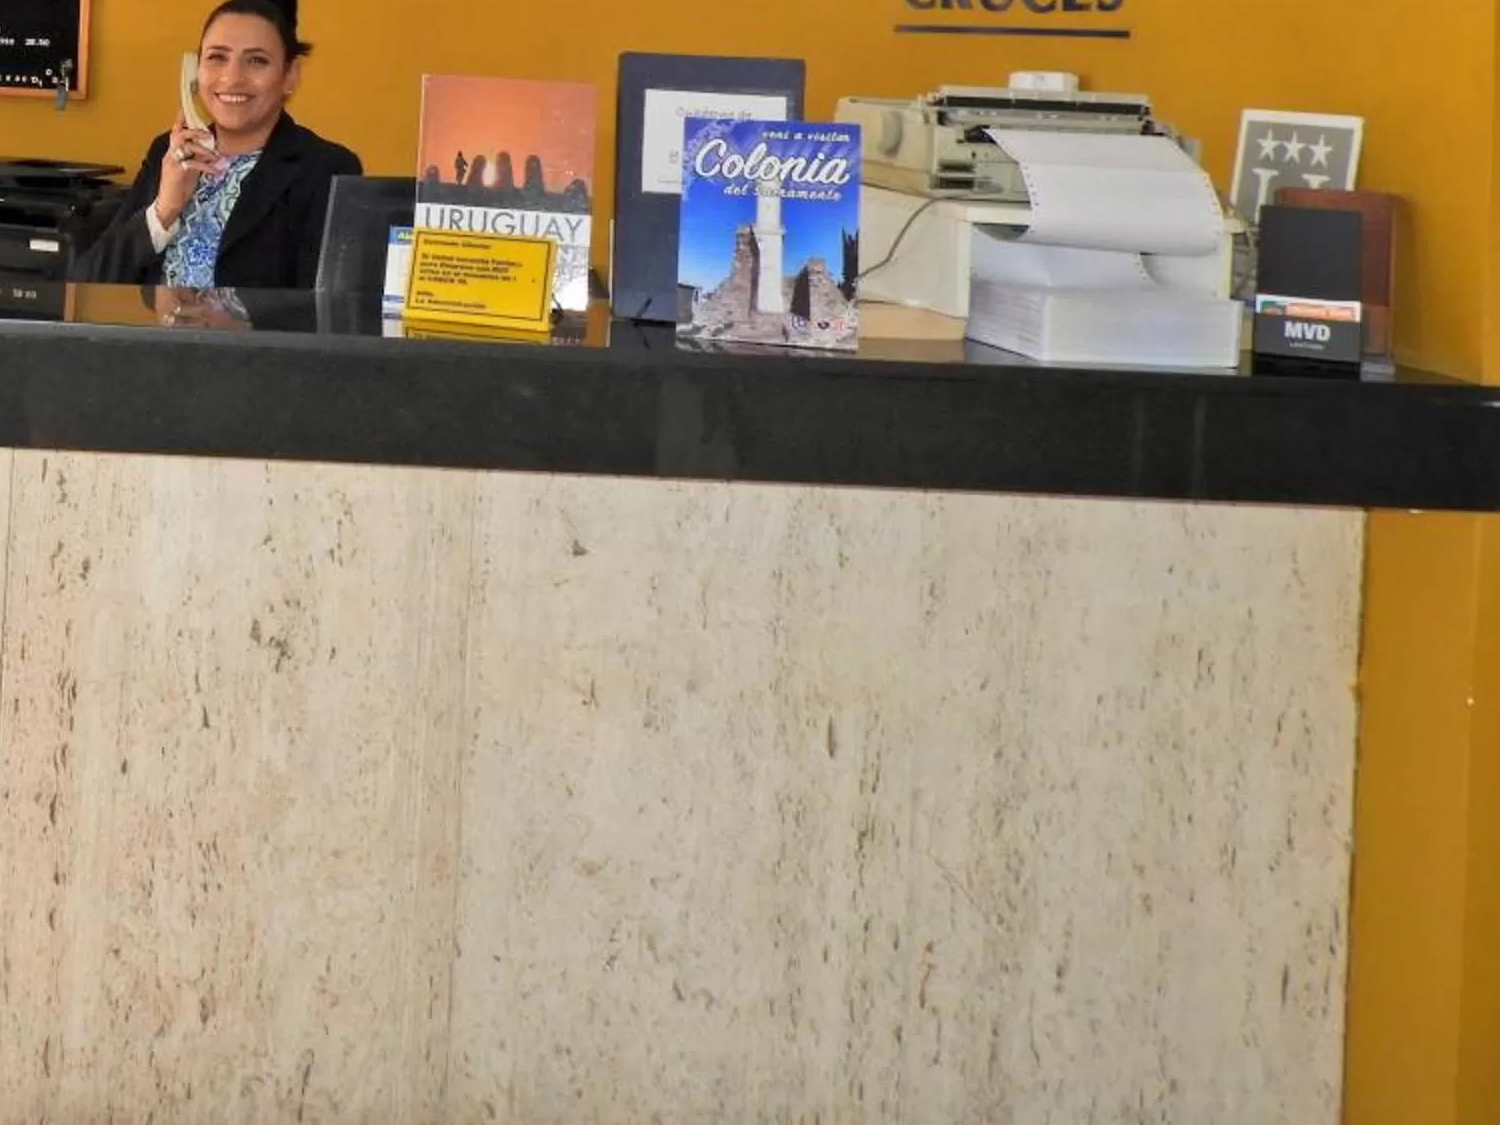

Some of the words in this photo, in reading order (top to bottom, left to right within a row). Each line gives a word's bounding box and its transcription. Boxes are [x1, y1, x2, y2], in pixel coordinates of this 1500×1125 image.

[695, 138, 851, 185] Colonia
[723, 183, 748, 197] del
[424, 205, 584, 243] URUGUAY
[1283, 320, 1331, 341] MVD
